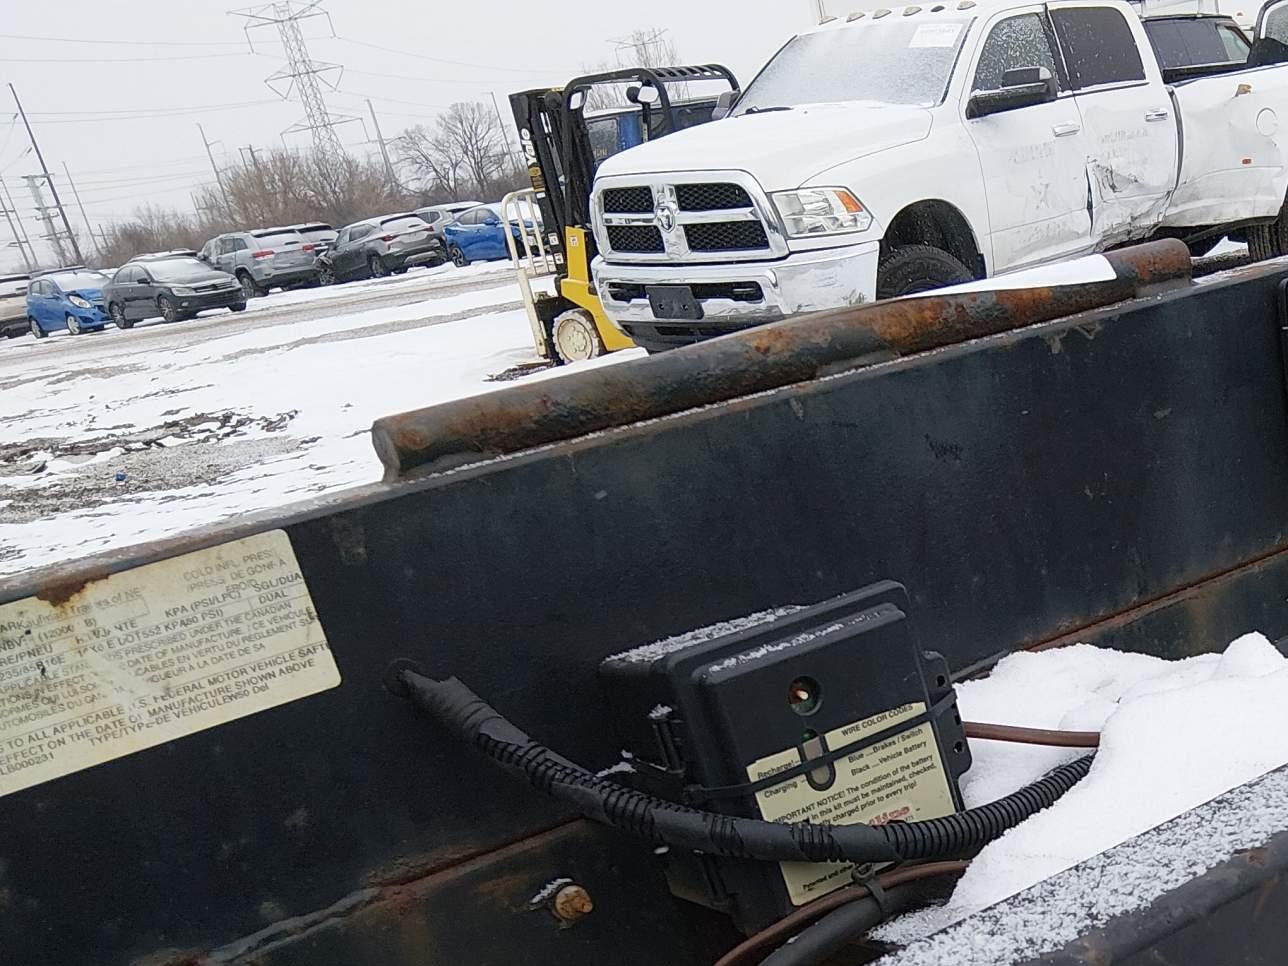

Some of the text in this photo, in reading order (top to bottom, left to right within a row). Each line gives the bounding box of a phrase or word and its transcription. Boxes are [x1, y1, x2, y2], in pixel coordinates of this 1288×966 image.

[258, 589, 287, 604] DUAL
[165, 605, 187, 618] KPA
[190, 623, 221, 637] UNDER
[225, 616, 243, 627] THE
[127, 654, 153, 667] DATE
[171, 628, 241, 655] MANUFACTURE
[177, 654, 190, 664] EN
[194, 644, 224, 659] VERTU
[227, 639, 239, 648] DU
[198, 660, 209, 668] LA
[211, 652, 235, 664] DATE
[238, 647, 250, 656] DE
[46, 675, 85, 692] EFFECT
[8, 739, 24, 749] TO
[27, 731, 48, 743] ALL
[52, 707, 124, 735] APPLICABLE
[207, 668, 248, 686] MOTOR
[251, 653, 296, 672] VEHICLE
[47, 738, 65, 749] ON
[70, 730, 91, 742] THE
[95, 718, 127, 734] DATE
[147, 685, 232, 717] MANUFACTURE
[234, 671, 275, 689] SHOWN
[278, 659, 314, 676] ABOVE
[842, 725, 860, 736] WIRE
[862, 715, 888, 728] COLOR
[848, 753, 864, 763] Blue
[900, 728, 923, 741] Switch
[851, 765, 869, 775] Black
[903, 742, 927, 754] Battery
[846, 786, 859, 794] The
[860, 774, 891, 788] condition
[911, 755, 933, 767] battery
[764, 782, 797, 798] Charging
[819, 807, 832, 816] this
[843, 796, 860, 806] must
[870, 776, 908, 794] maintained,
[908, 764, 936, 778] checked,
[831, 807, 859, 821] charged
[860, 800, 876, 810] prior
[885, 789, 903, 799] every
